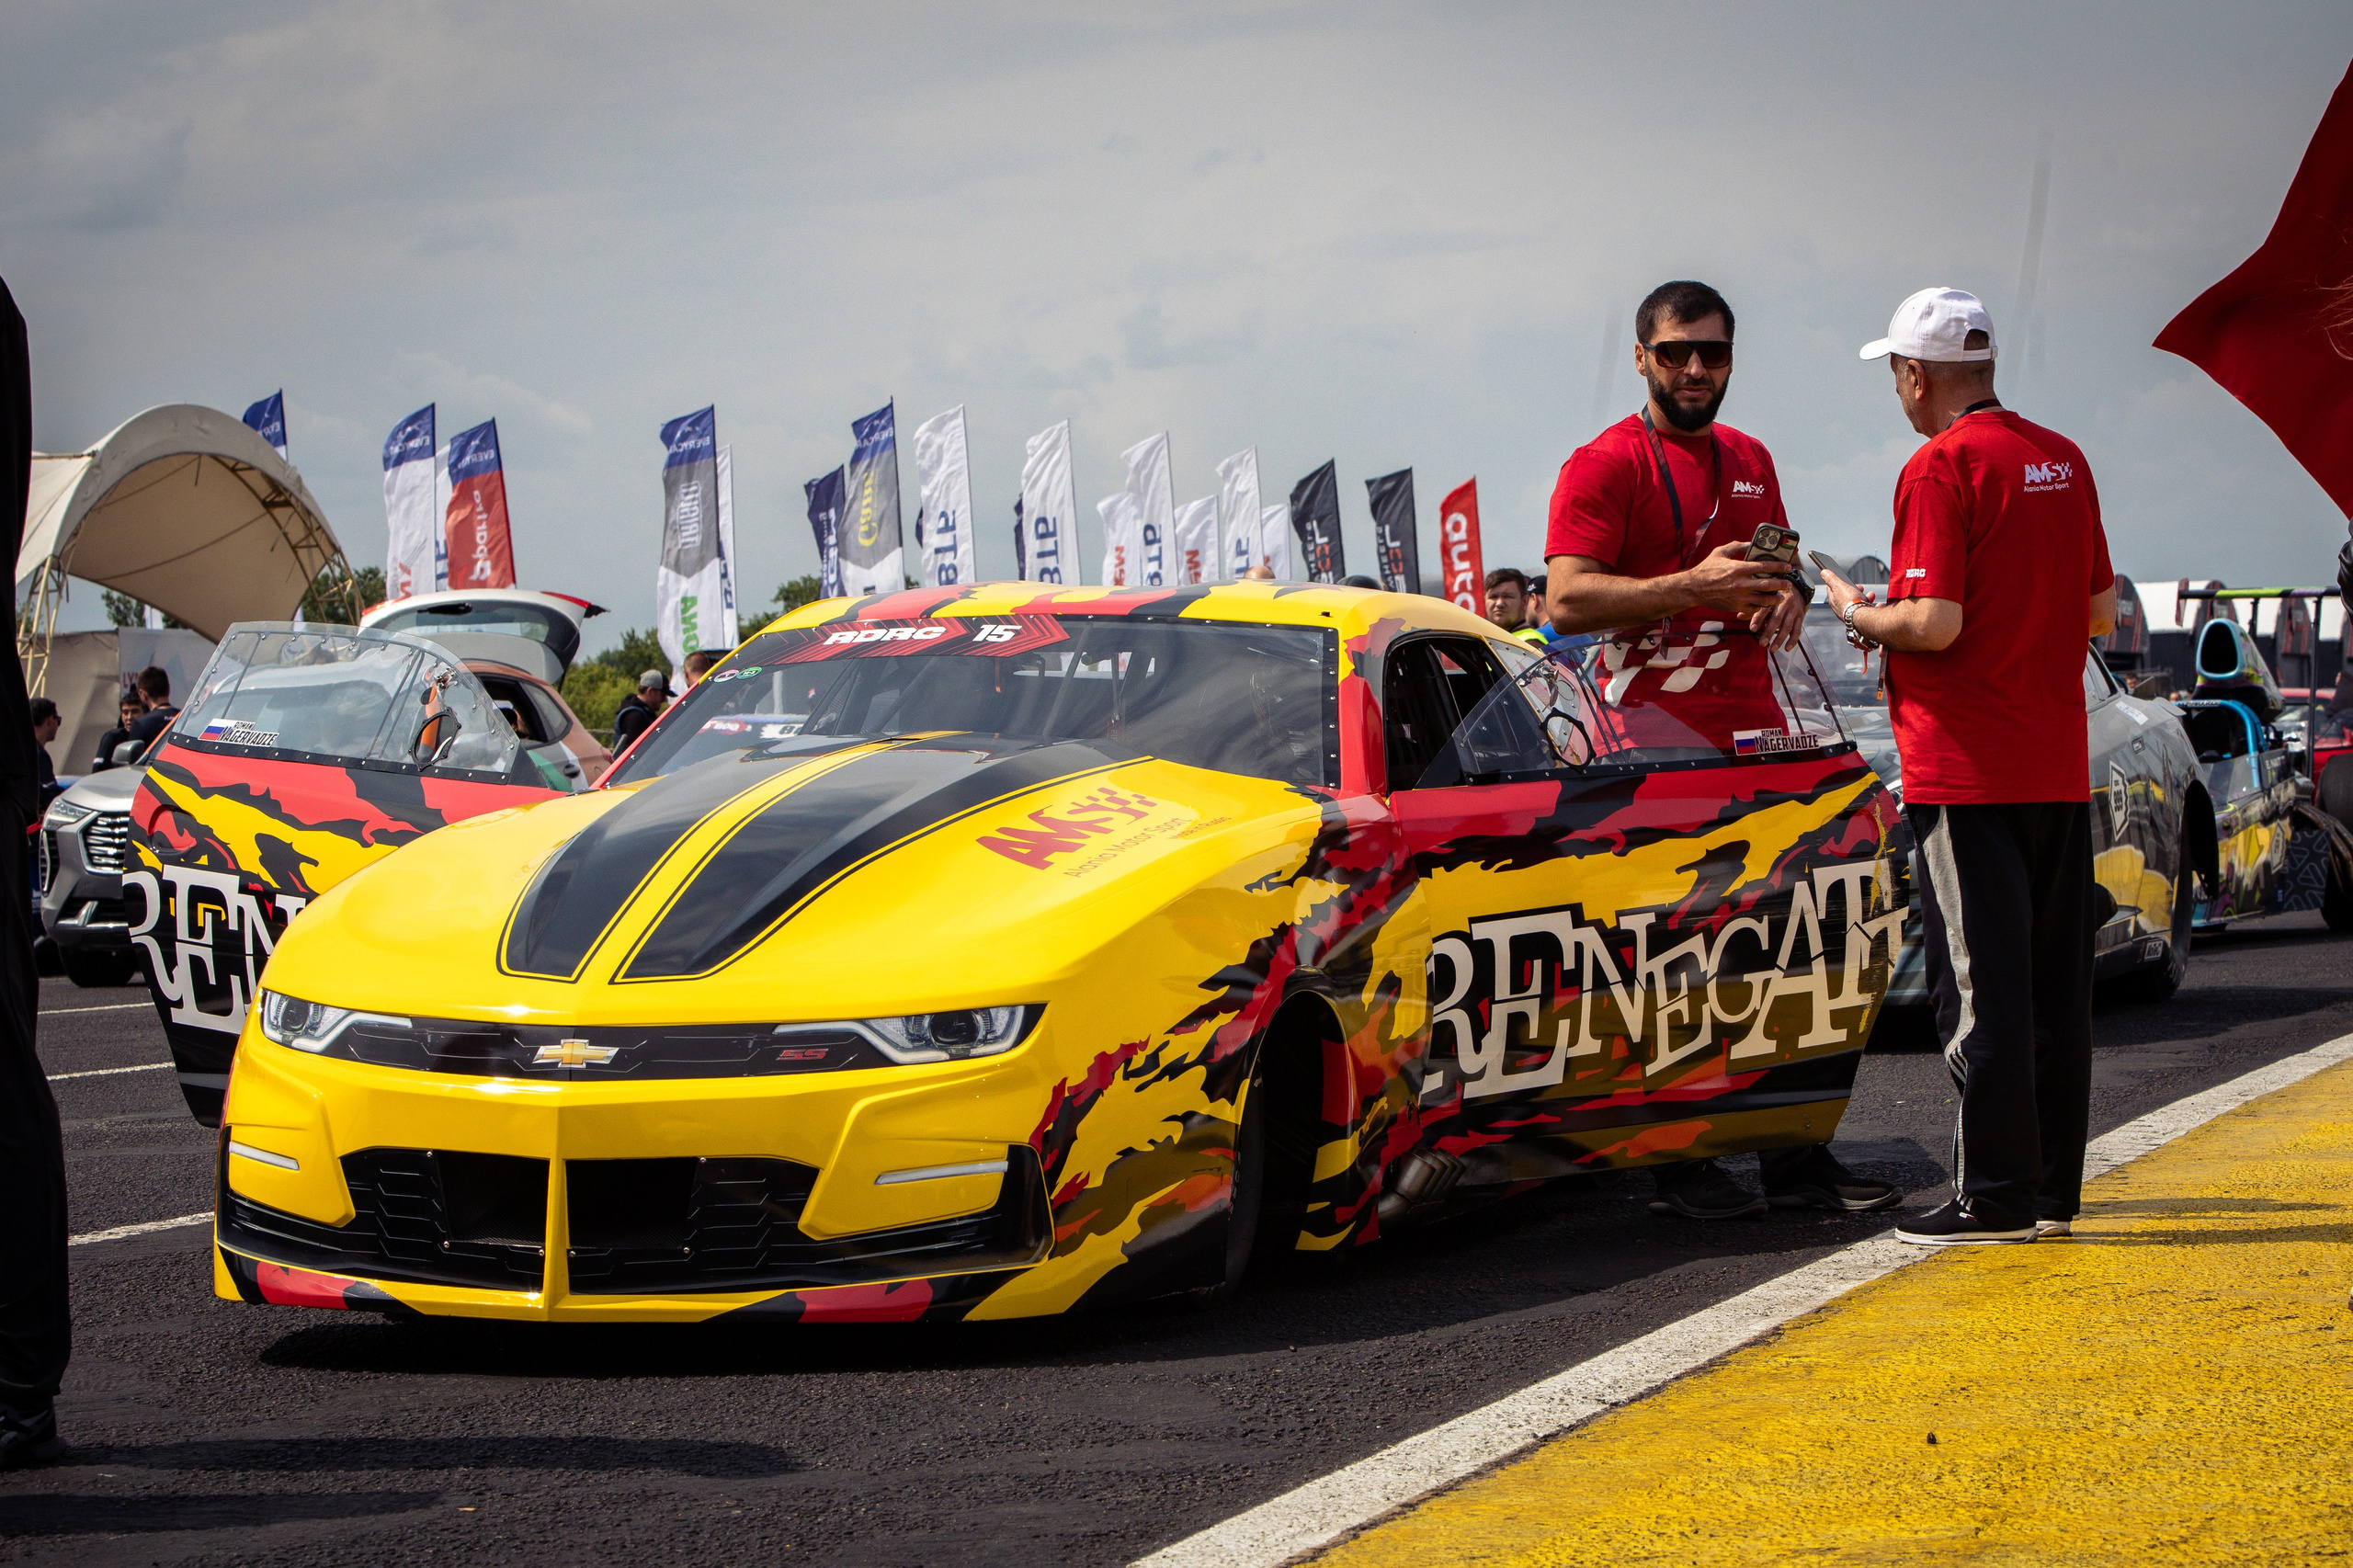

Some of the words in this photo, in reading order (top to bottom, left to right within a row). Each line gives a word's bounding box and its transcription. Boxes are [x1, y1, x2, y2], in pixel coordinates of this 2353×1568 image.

[972, 624, 1023, 642] 15
[1761, 729, 1783, 738] ROMAN
[1755, 734, 1819, 754] NAGERVADZE
[1063, 846, 1117, 879] Alania
